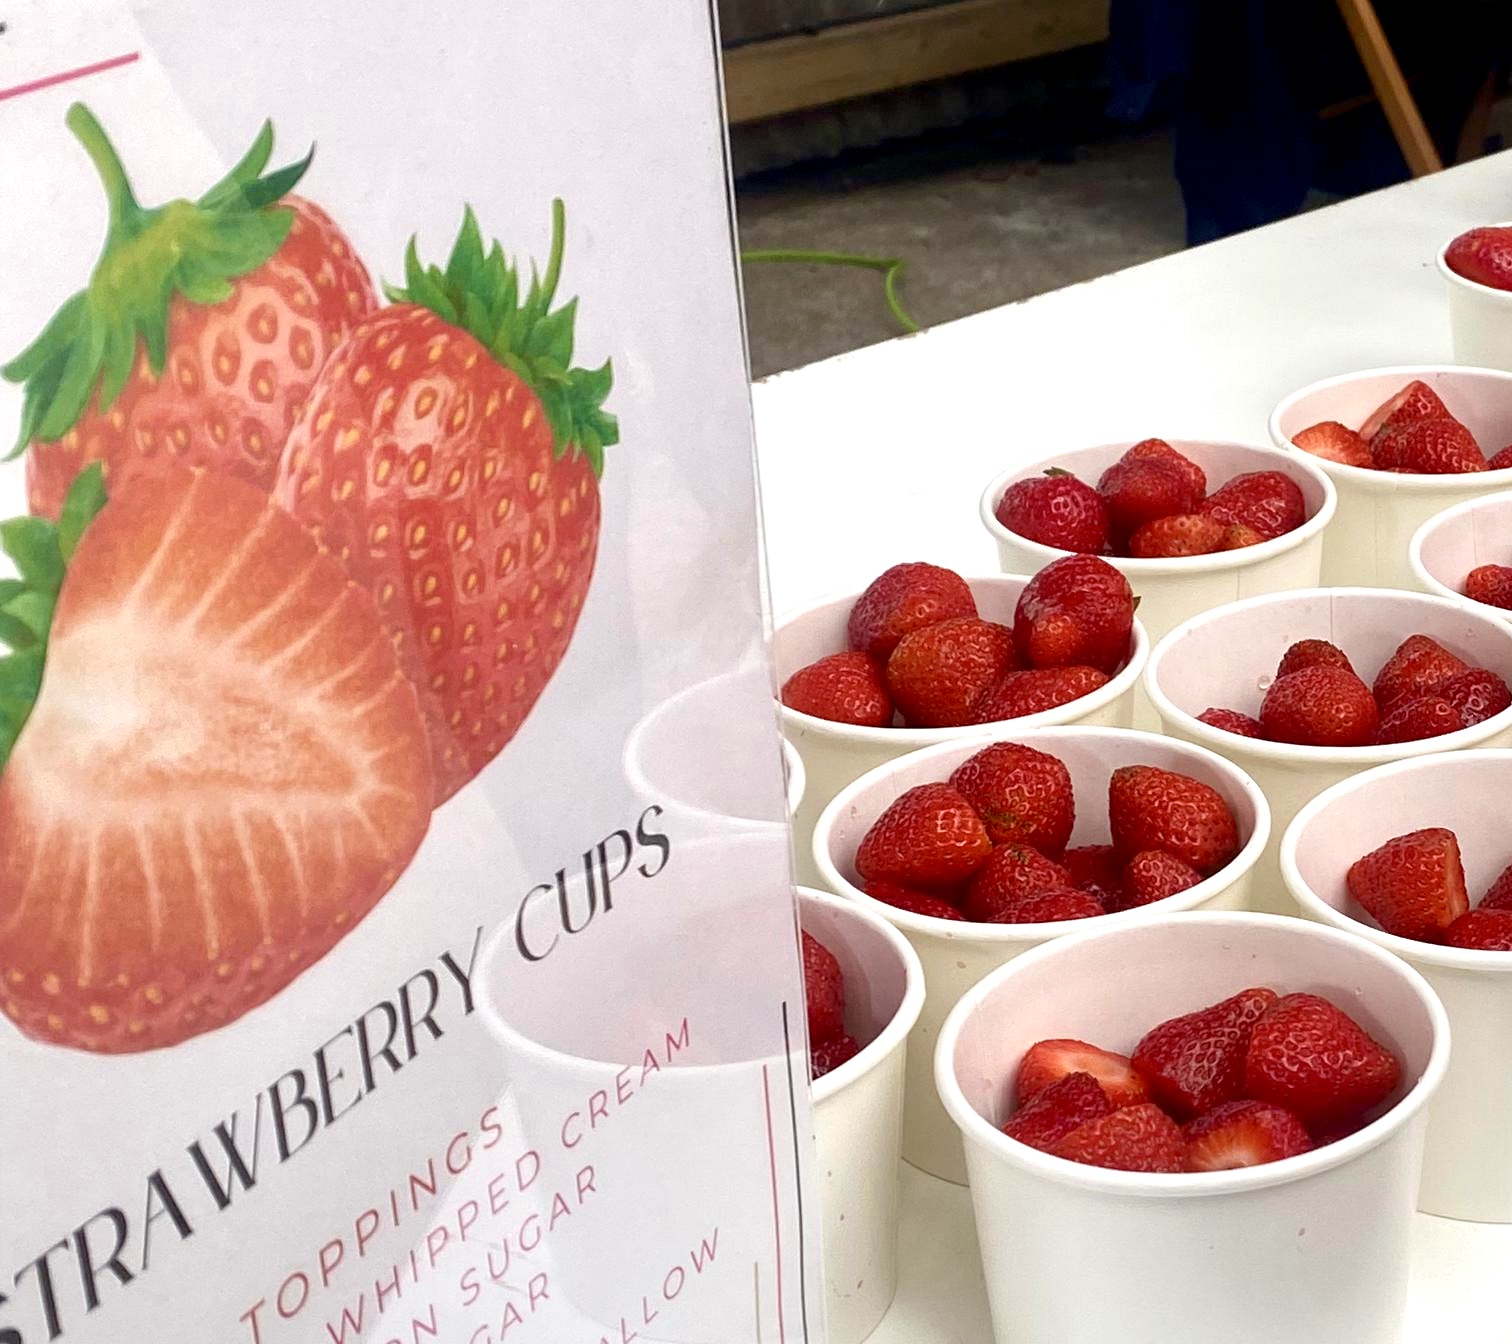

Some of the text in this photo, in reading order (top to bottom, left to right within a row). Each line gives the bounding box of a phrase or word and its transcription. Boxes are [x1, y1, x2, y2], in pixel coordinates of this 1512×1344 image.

[515, 804, 672, 963] CUPS
[560, 1019, 693, 1148] CREAM
[461, 1164, 598, 1307] SUGAR
